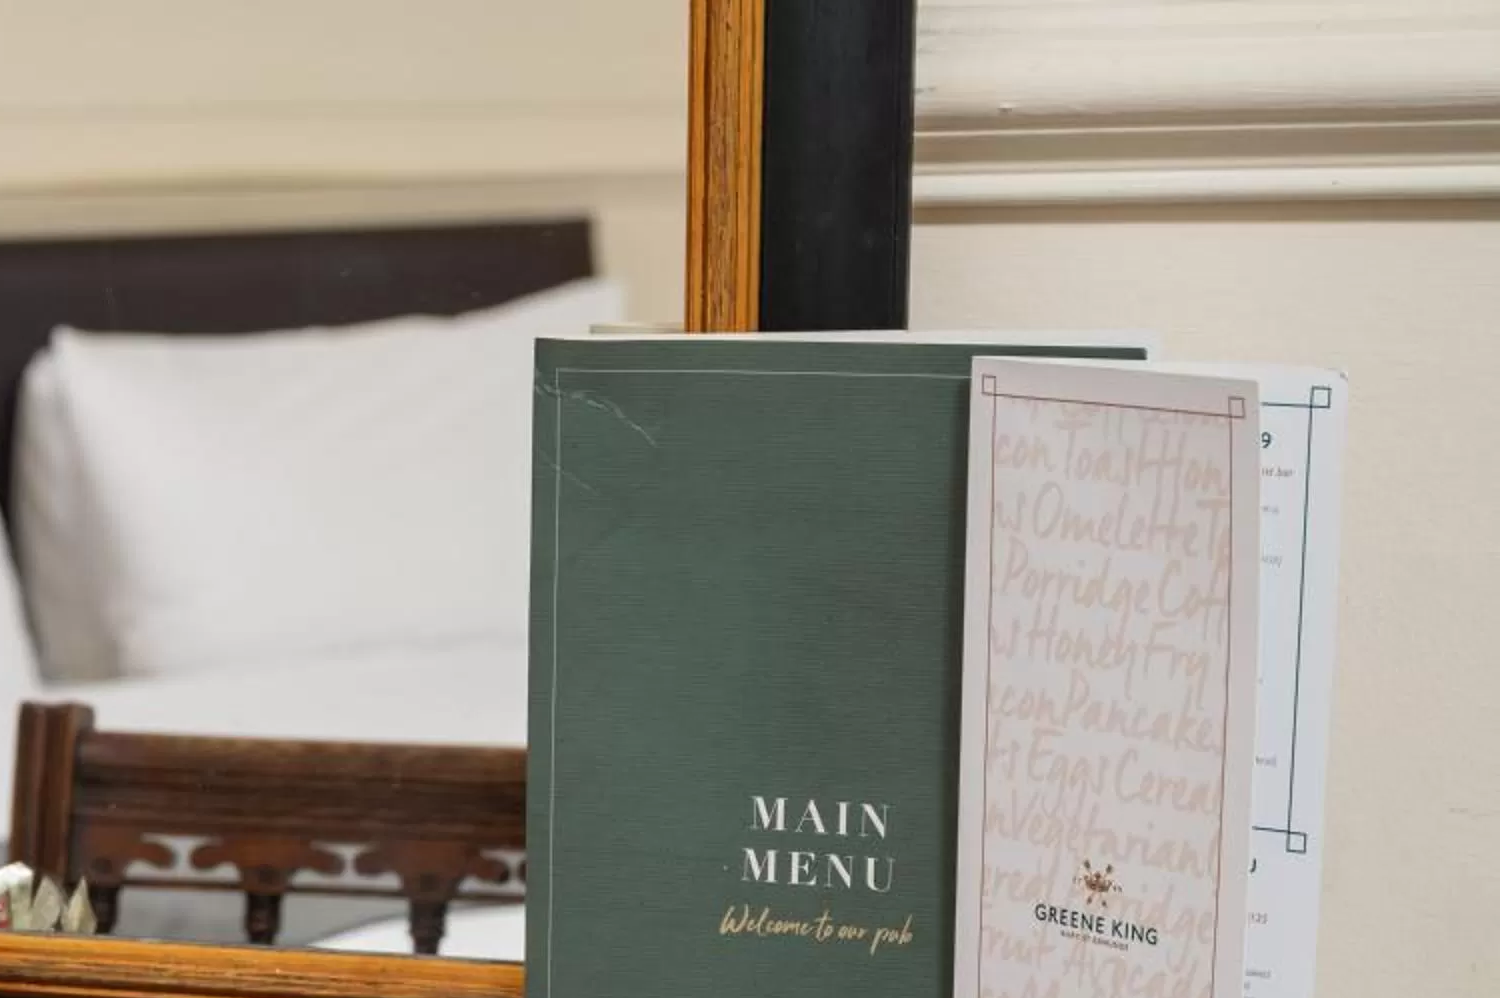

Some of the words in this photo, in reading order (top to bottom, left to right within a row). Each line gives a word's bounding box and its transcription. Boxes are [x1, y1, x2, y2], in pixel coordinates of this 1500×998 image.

[750, 796, 894, 840] MAIN
[741, 847, 896, 892] MENU
[719, 903, 813, 938] Welcome
[813, 907, 833, 942] to
[838, 924, 864, 942] our
[870, 913, 913, 956] pub
[1035, 903, 1105, 935] GREENE
[1111, 920, 1159, 946] KING
